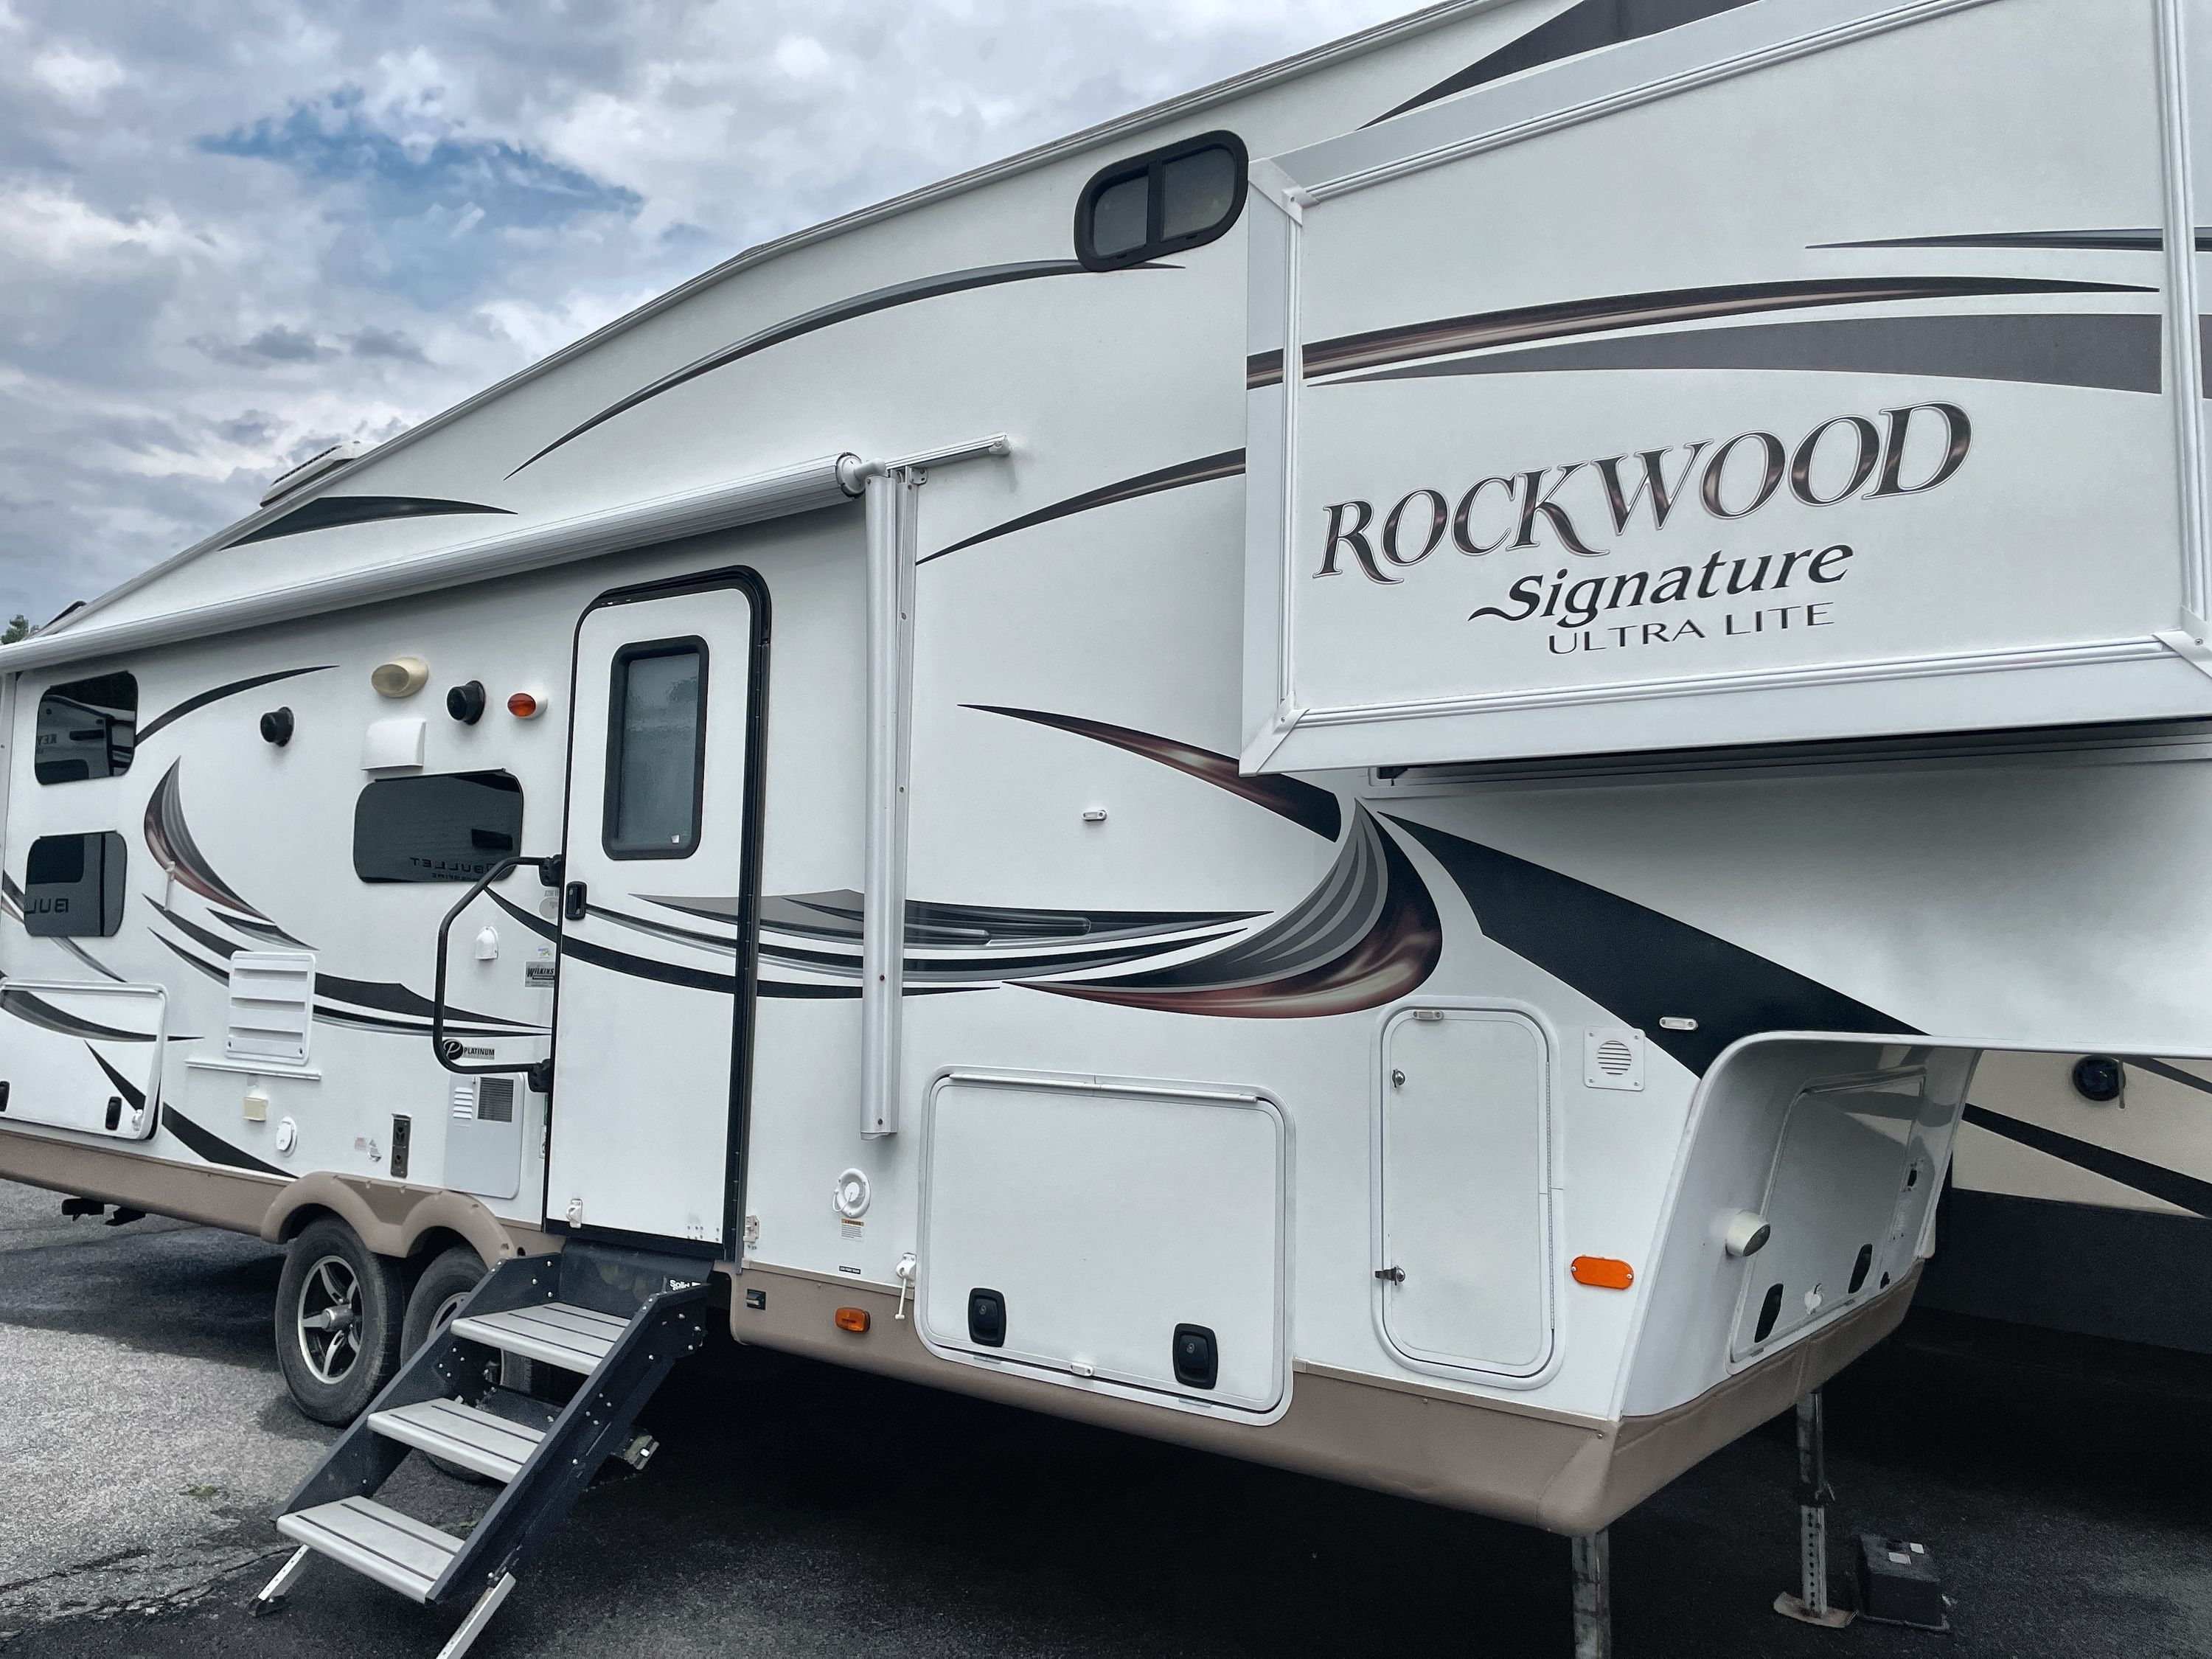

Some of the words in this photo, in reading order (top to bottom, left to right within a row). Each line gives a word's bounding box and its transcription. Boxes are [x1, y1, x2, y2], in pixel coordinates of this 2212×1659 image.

[1312, 400, 1973, 585] ROCKWOOD
[1468, 543, 1854, 628] Signature
[1548, 619, 1705, 654] ULTRA
[1725, 602, 1835, 636] LITE
[526, 967, 554, 978] WILKINS
[463, 1047, 495, 1056] PLATINUM
